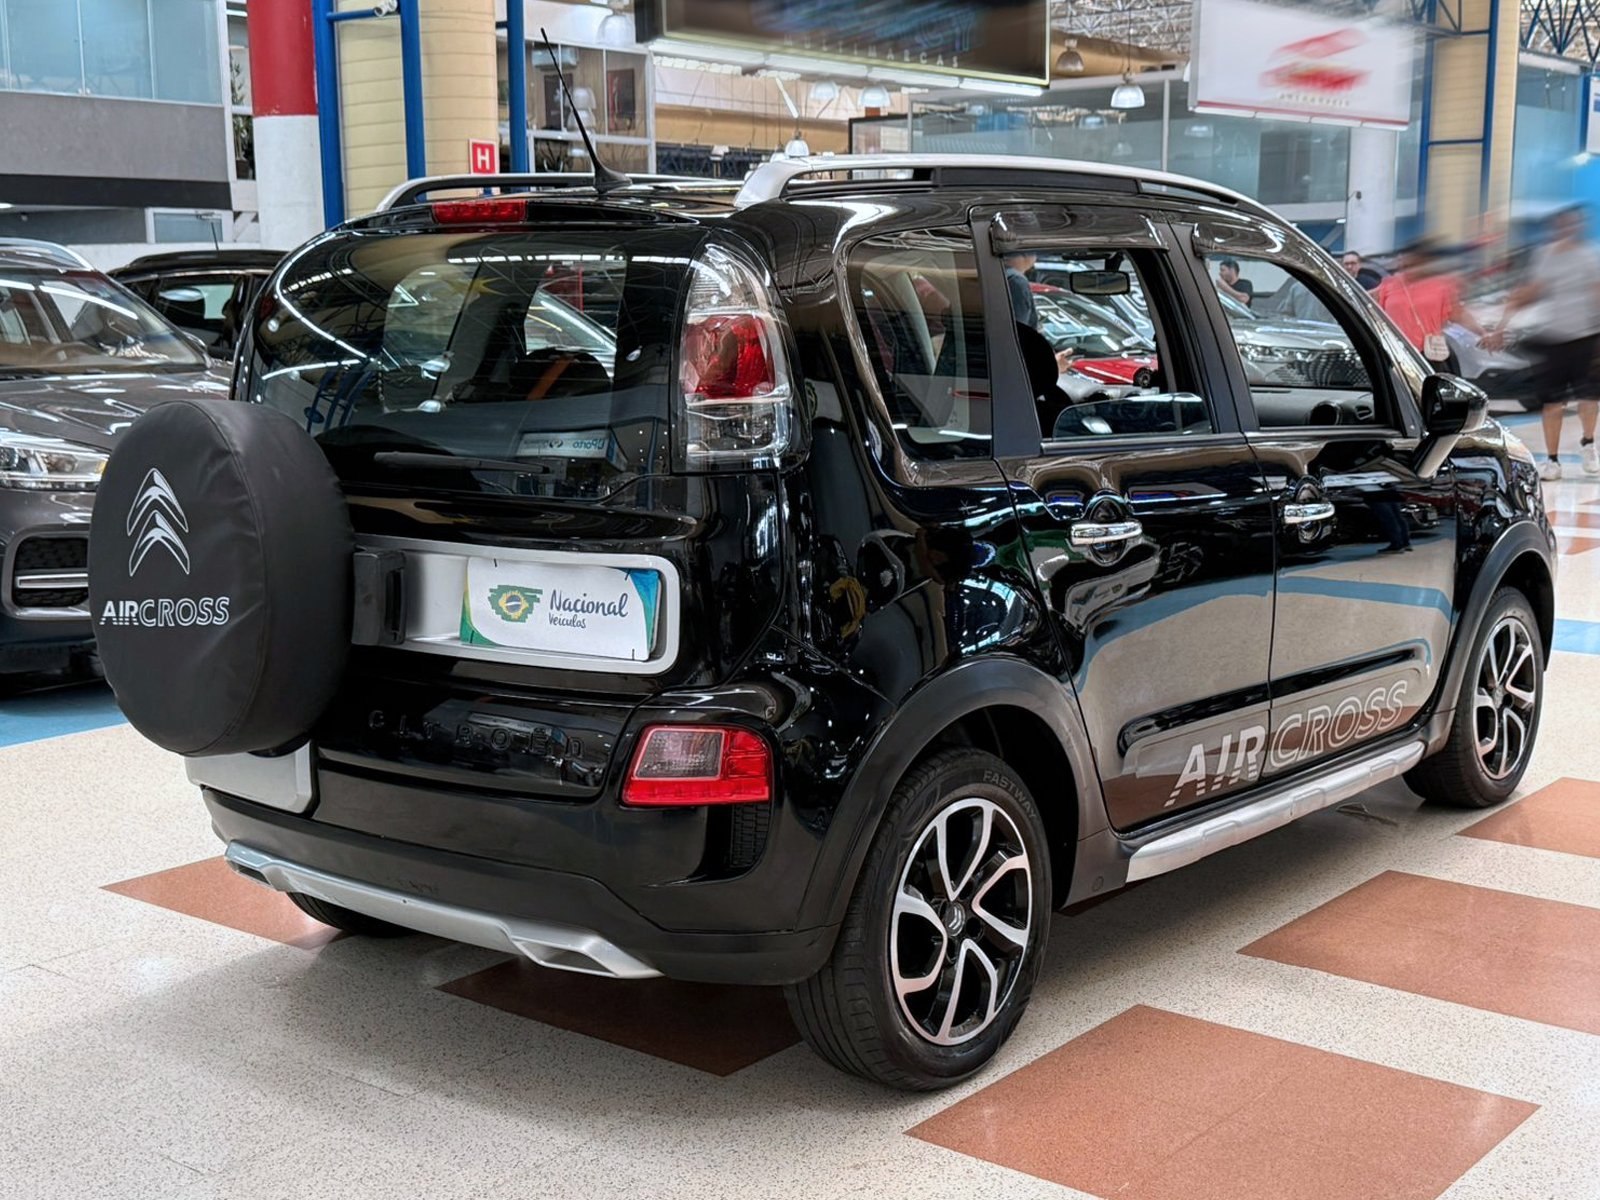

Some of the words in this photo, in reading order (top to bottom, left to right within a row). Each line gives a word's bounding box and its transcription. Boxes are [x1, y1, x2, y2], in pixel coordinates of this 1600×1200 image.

[476, 147, 490, 170] H
[99, 597, 230, 627] AIRCROSS
[549, 589, 628, 618] Nacional
[1164, 680, 1408, 807] AIRCROSS
[982, 769, 1038, 819] FASTWAY
